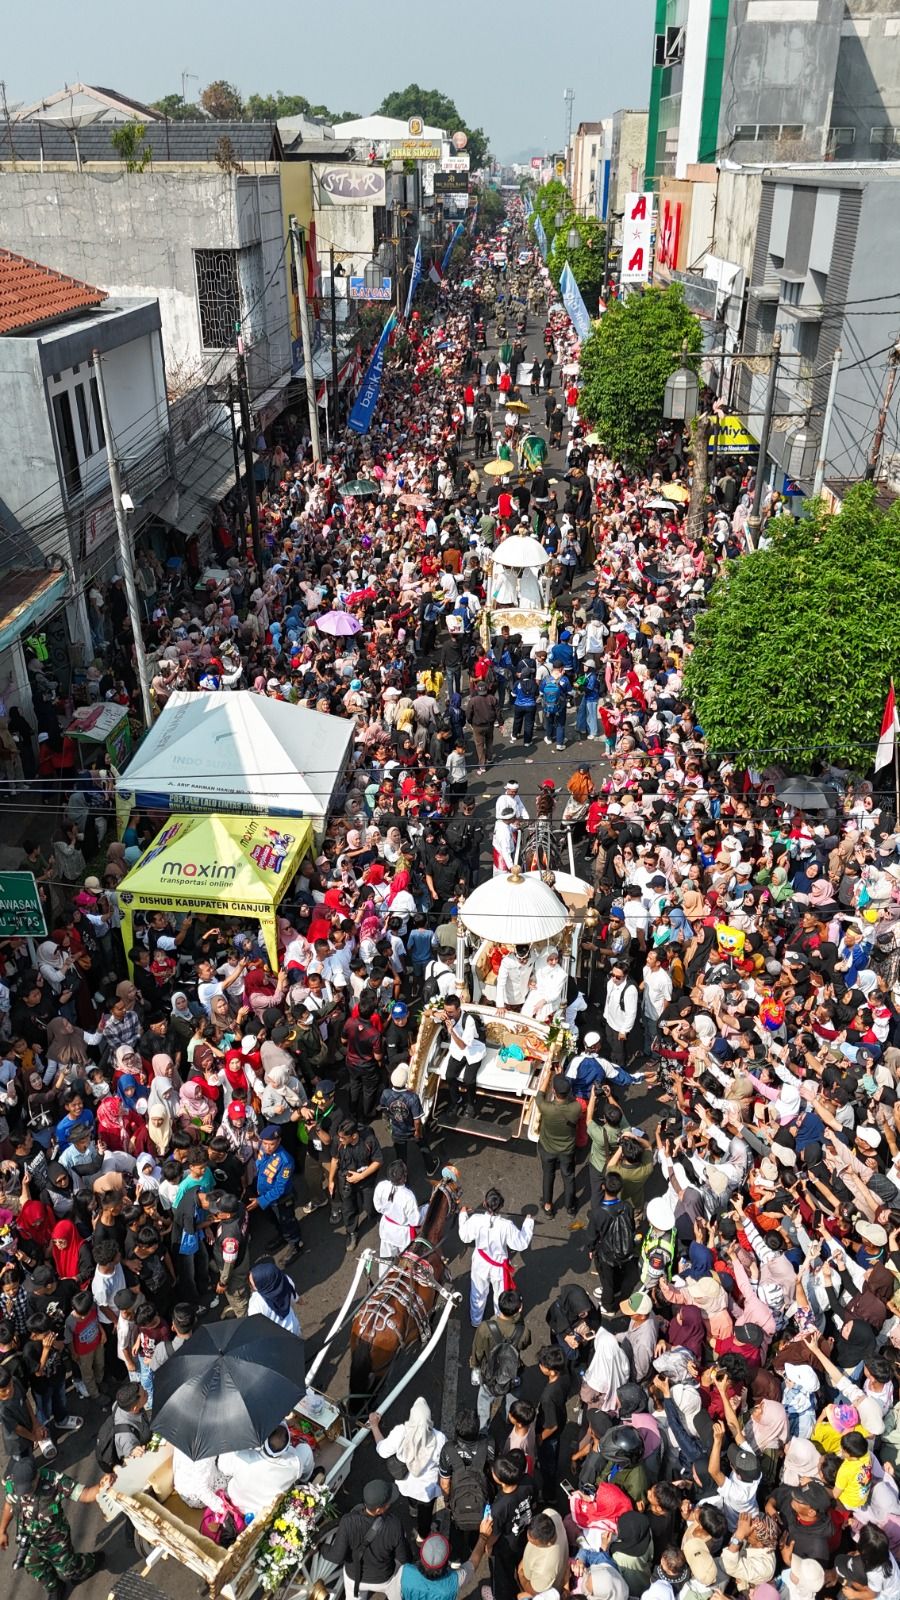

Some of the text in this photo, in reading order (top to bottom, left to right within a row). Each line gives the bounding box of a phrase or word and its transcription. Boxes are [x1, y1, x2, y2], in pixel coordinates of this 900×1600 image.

[631, 196, 646, 220] A
[628, 247, 643, 271] A
[359, 376, 381, 408] bank
[240, 819, 259, 849] maxim
[160, 876, 234, 888] transportasi online
[161, 860, 236, 880] maxim
[139, 896, 271, 913] DISHUB KABUPATEN CIANJUR
